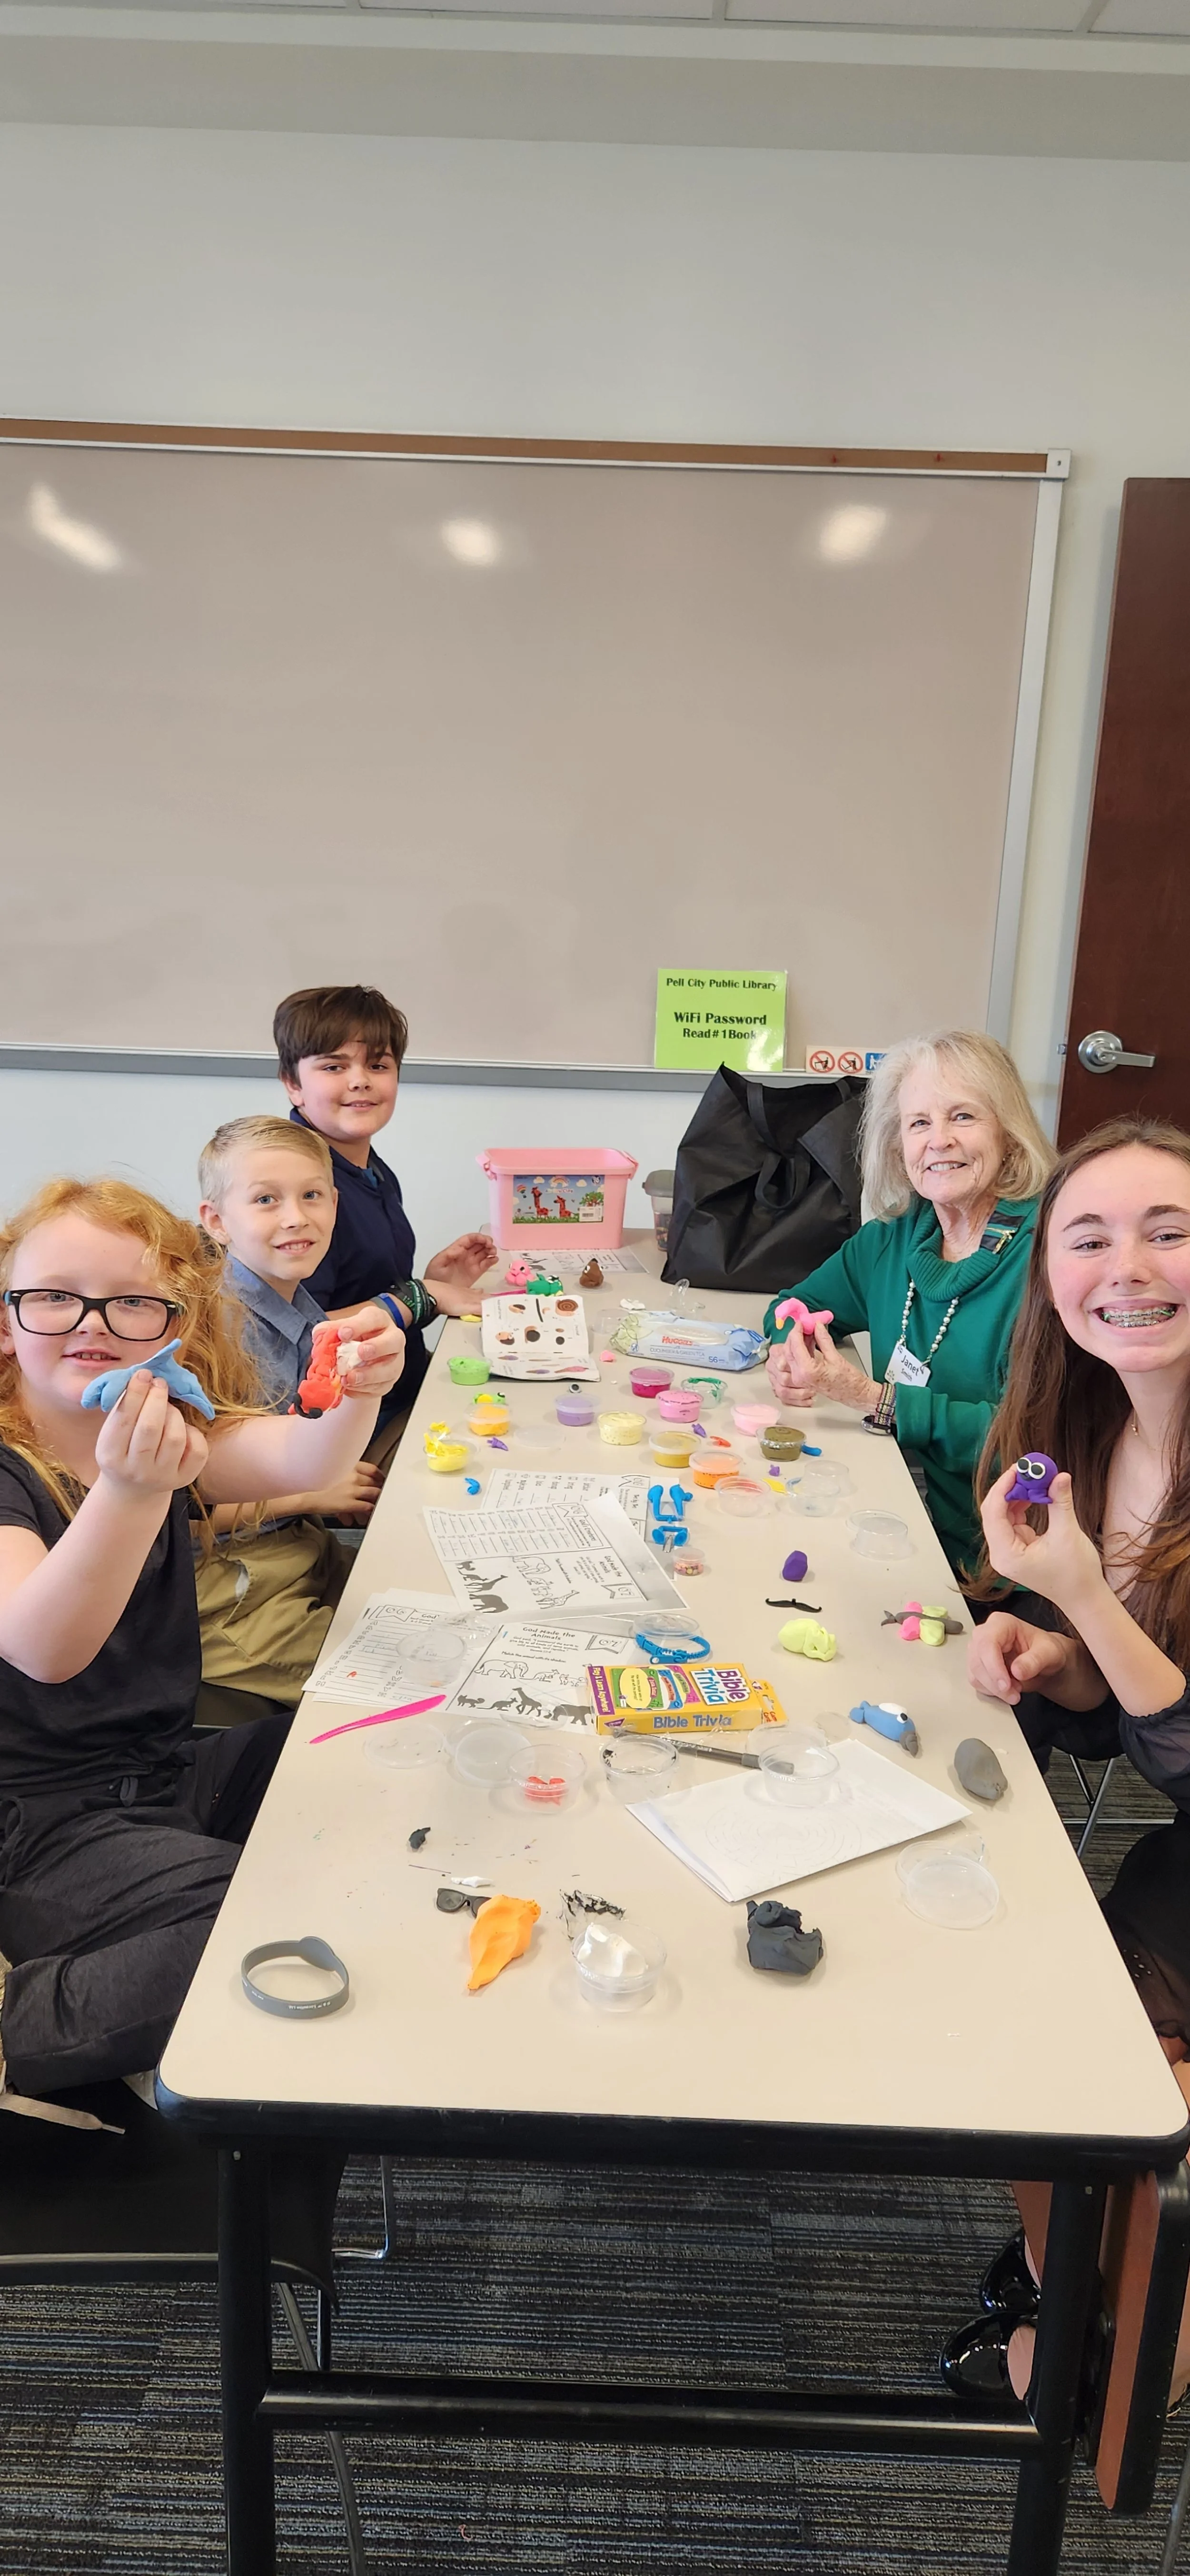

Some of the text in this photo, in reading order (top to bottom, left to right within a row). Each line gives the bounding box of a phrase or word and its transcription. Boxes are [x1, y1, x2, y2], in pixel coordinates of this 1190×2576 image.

[666, 978, 776, 991] Pell City Public Library
[674, 1012, 767, 1025] WiFi Password
[901, 1355, 919, 1376] Janet
[901, 1368, 912, 1382] Smith
[694, 1669, 725, 1703] Trivia
[716, 1670, 747, 1700] Bible
[654, 1714, 732, 1729] Bible Trivia
